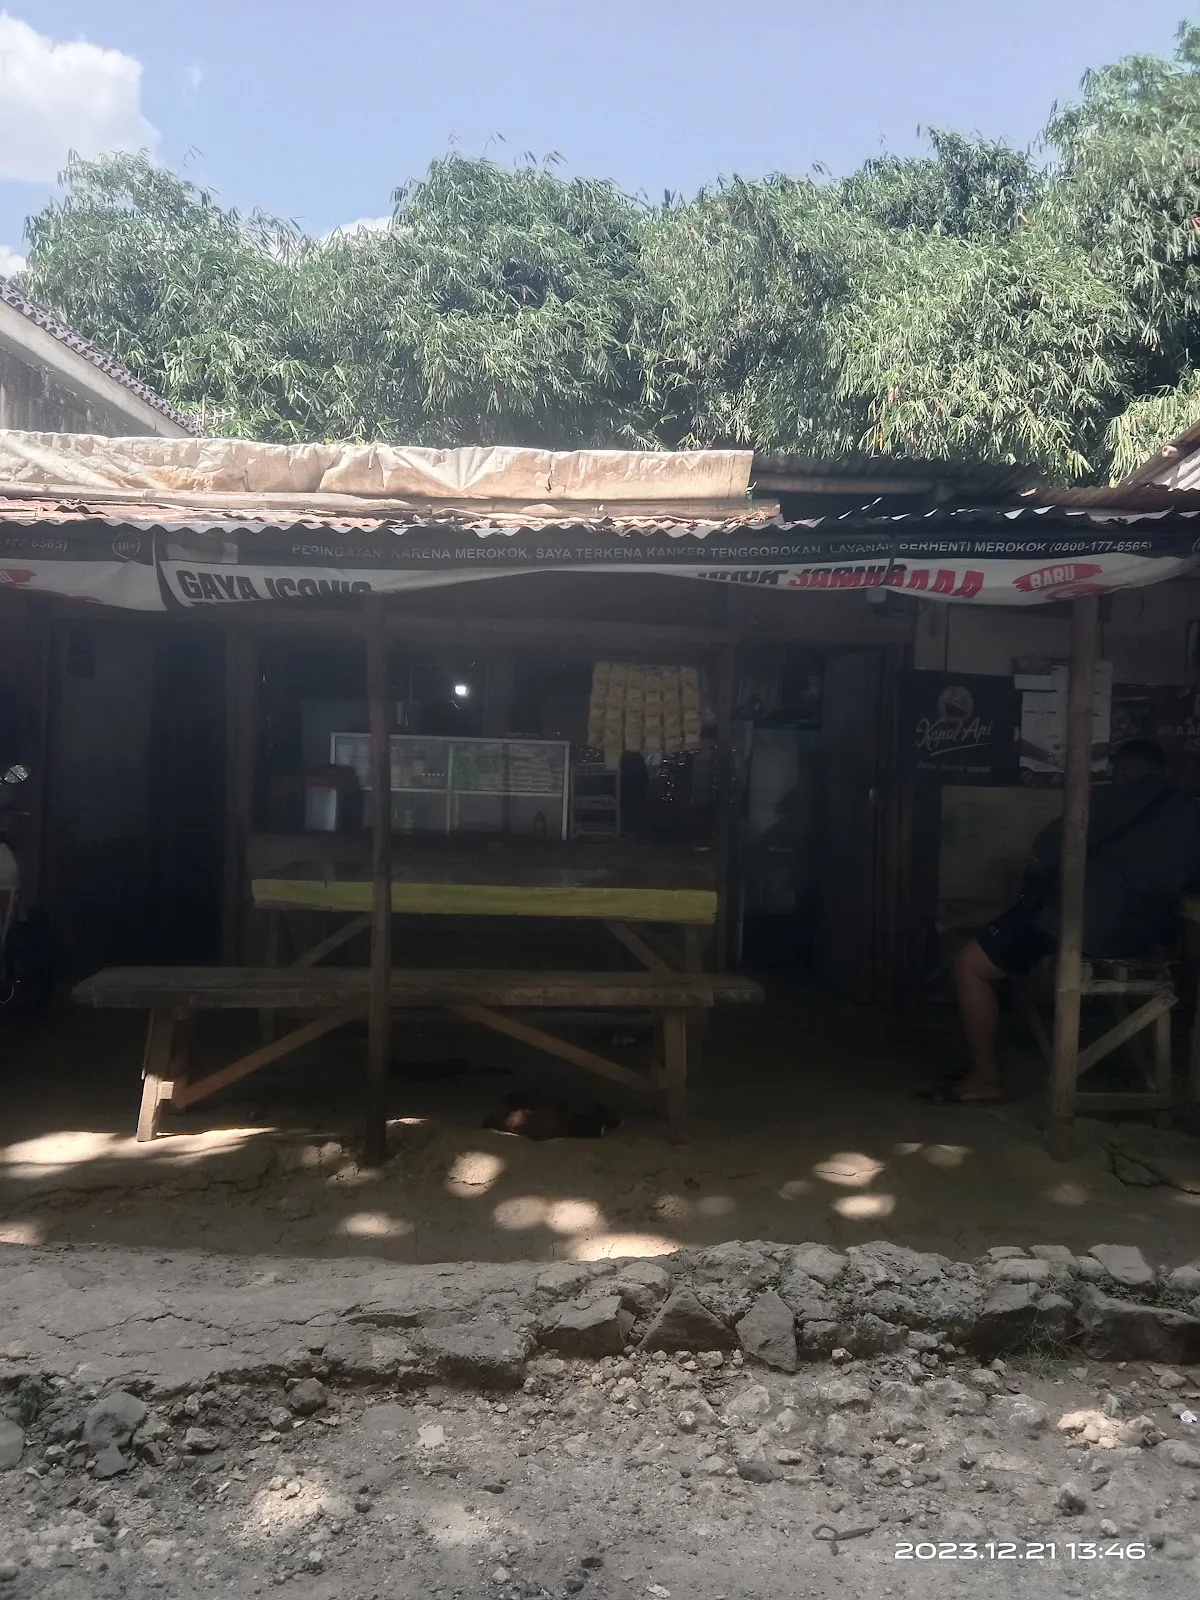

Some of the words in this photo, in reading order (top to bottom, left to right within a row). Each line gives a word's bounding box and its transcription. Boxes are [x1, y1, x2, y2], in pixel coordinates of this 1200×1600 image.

[391, 548, 452, 559] KARENA
[536, 547, 572, 560] SAYA
[576, 547, 642, 559] TERKENA
[646, 546, 706, 559] KANKER
[974, 541, 1048, 553] MEROKOK
[176, 569, 264, 600] GAYA
[1029, 565, 1075, 589] BARU
